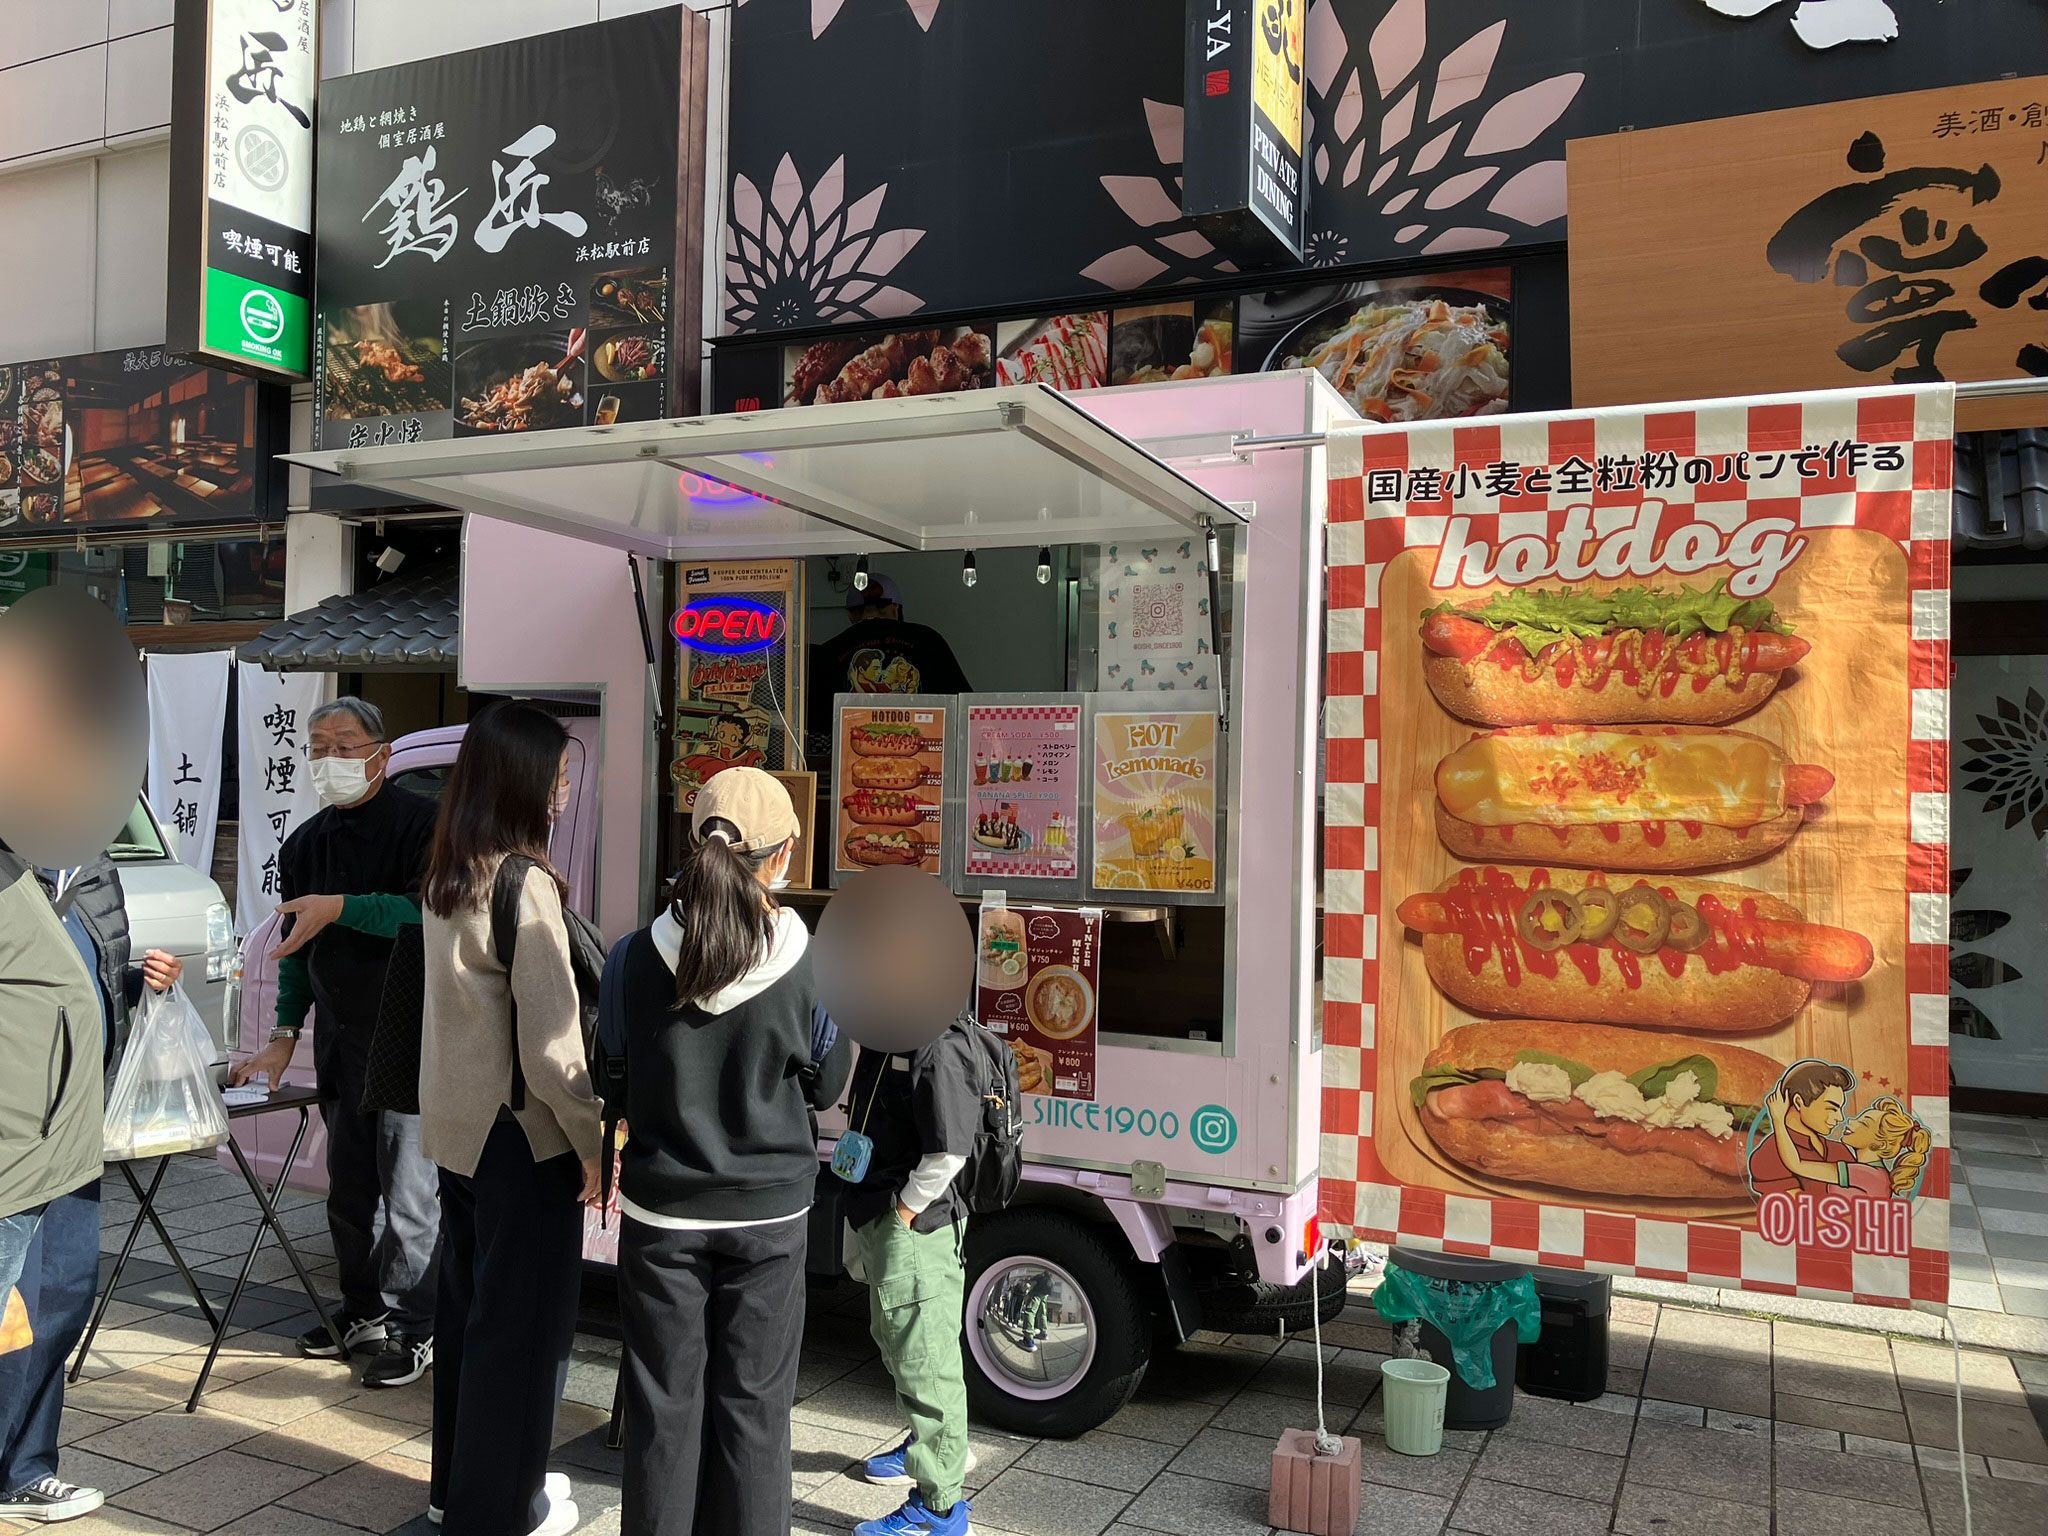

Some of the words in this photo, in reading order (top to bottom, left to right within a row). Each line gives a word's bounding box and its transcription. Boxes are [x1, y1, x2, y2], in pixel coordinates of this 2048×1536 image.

[226, 0, 311, 129] 匠
[340, 105, 417, 133] 地鶏と網焼き
[212, 93, 230, 188] 浜松駅前店
[378, 122, 446, 149] 個室居酒屋
[1253, 123, 1298, 195] PRIVATE
[1256, 165, 1294, 227] DINING
[222, 229, 301, 274] 喫煙可能
[575, 237, 651, 262] 浜松駅前店
[462, 282, 576, 330] 土鍋炊き
[241, 340, 271, 354] SMOKING
[272, 348, 282, 357] OK
[1367, 440, 1906, 503] 国産小麦と全粒粉のパンで作る
[1431, 498, 1808, 599] hotdog
[675, 609, 776, 638] OPEN
[871, 710, 910, 723] HOTDOG
[981, 731, 1008, 739] CREAM
[1128, 722, 1179, 748] HOT
[1104, 756, 1206, 781] Lemonade
[172, 752, 203, 838] 土鍋
[262, 703, 297, 896] 喫煙可能
[977, 791, 1011, 799] BANANA
[1176, 878, 1211, 889] ¥400
[1071, 939, 1082, 972] MENU
[1083, 917, 1095, 967] WINTER
[1031, 954, 1050, 964] ¥750
[1009, 1022, 1030, 1032] ¥600
[1058, 1056, 1081, 1067] ¥800
